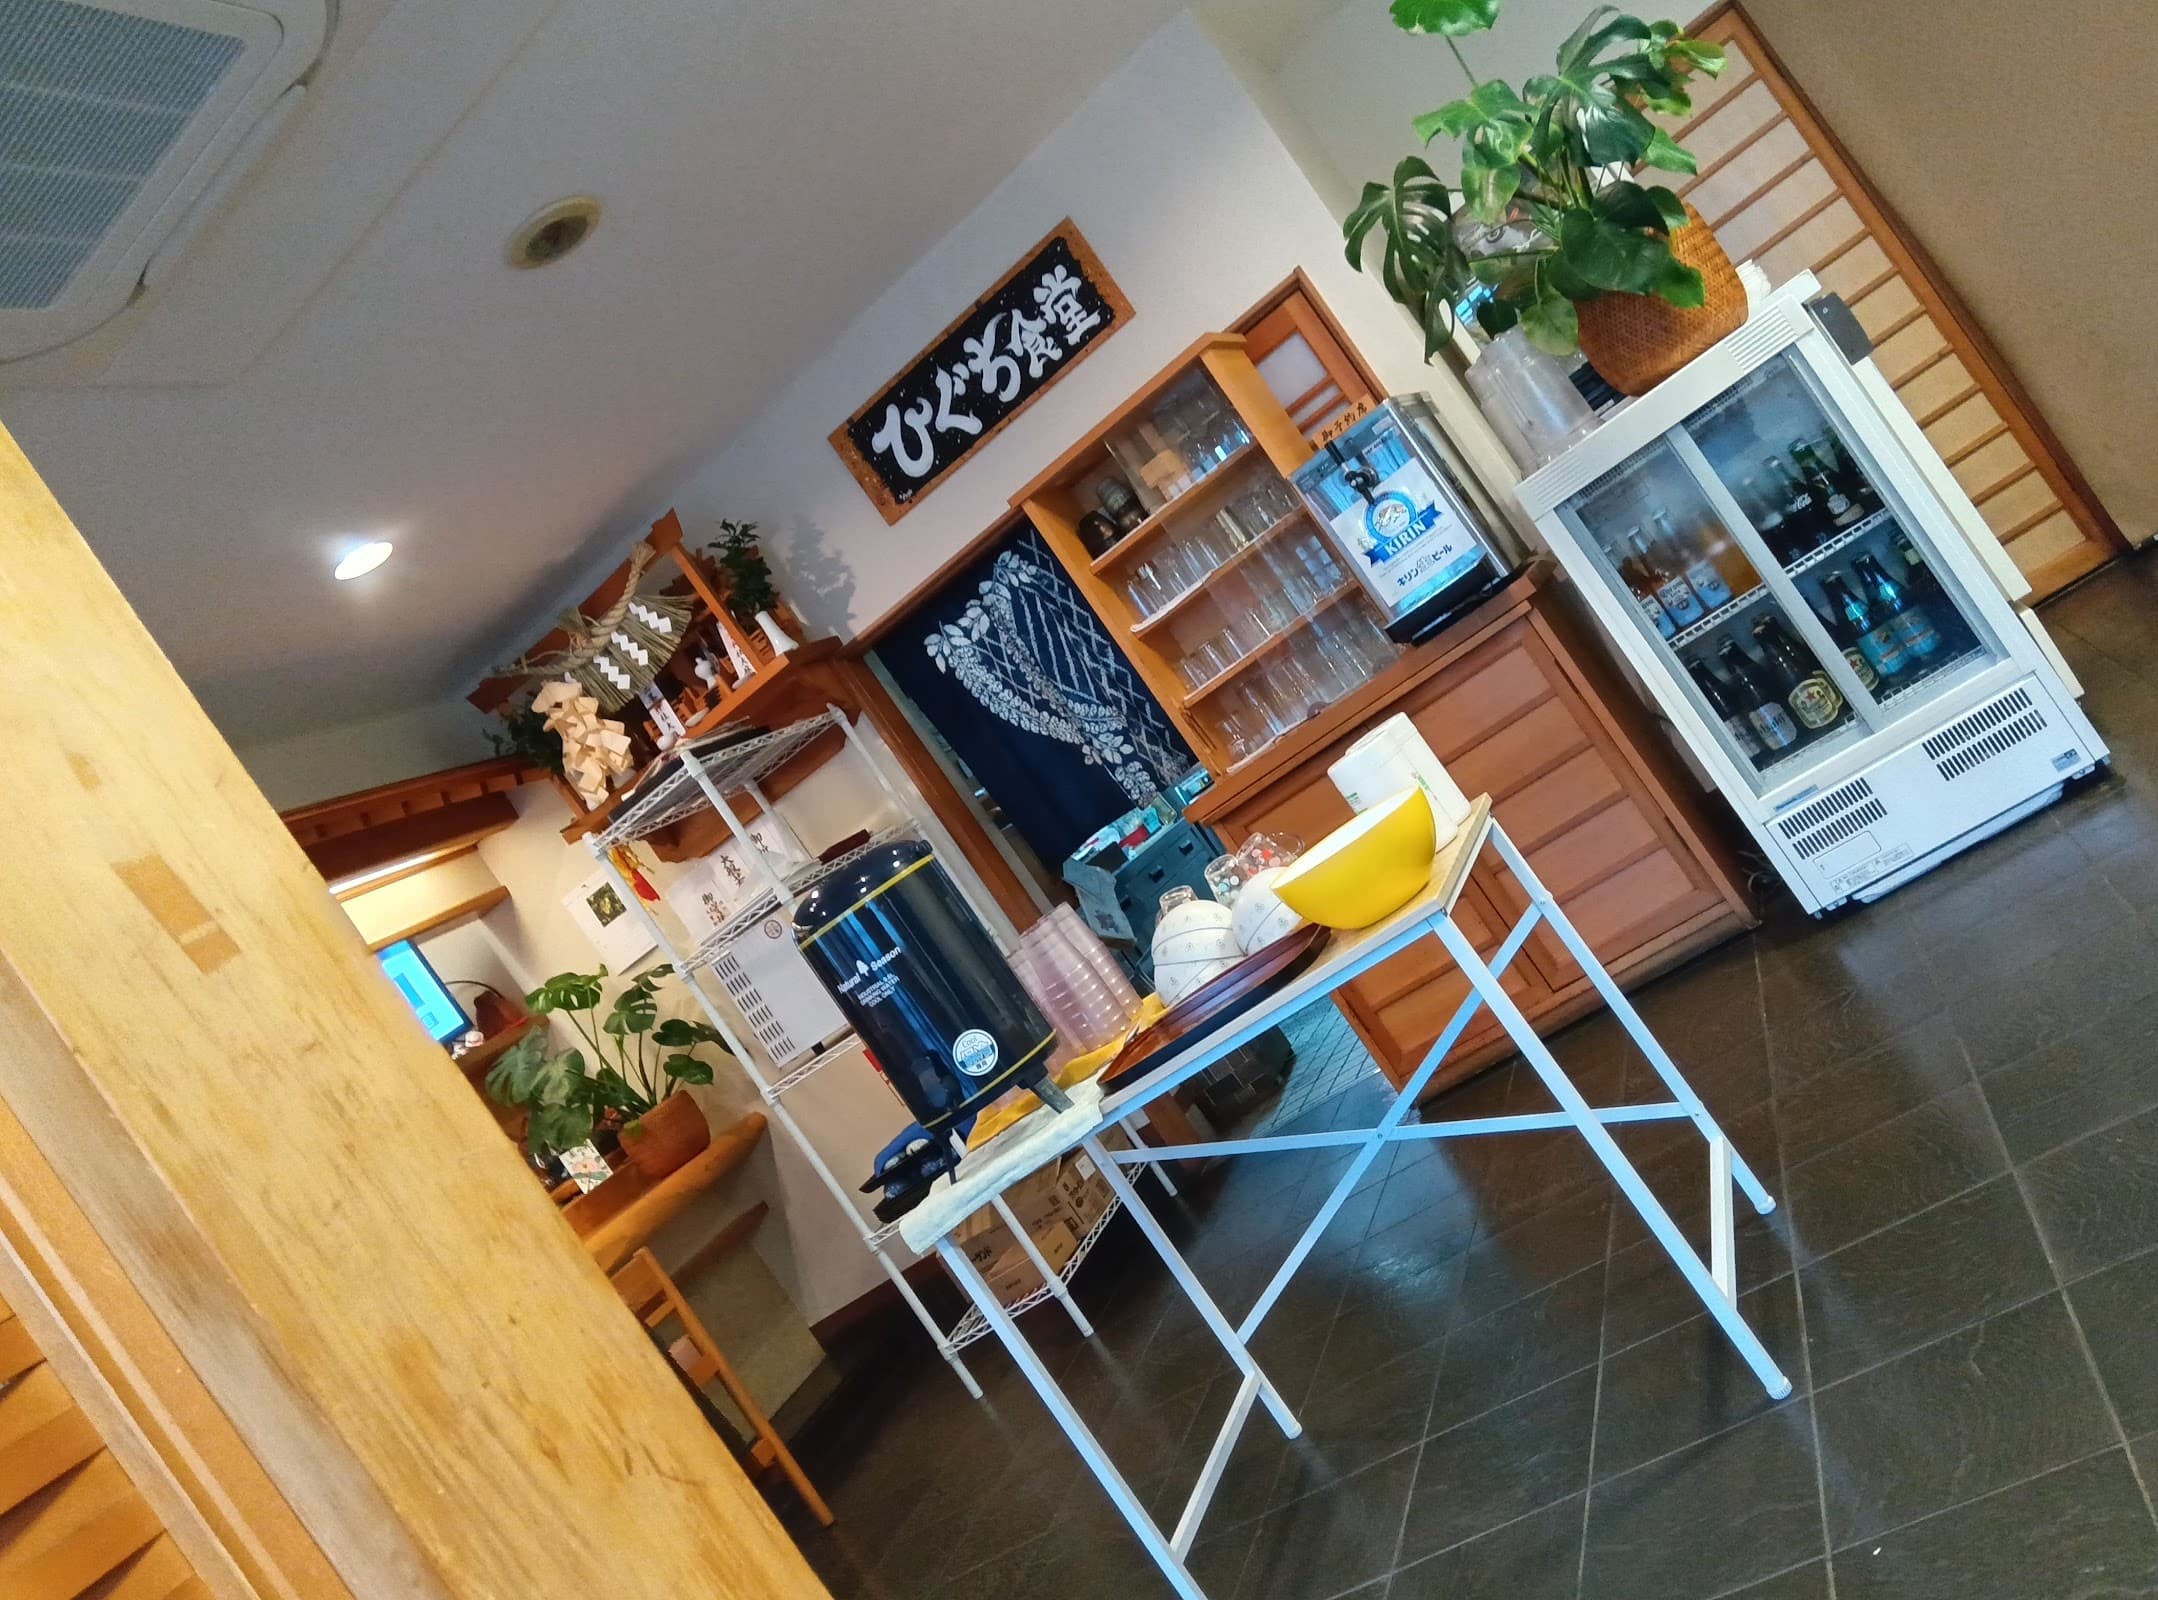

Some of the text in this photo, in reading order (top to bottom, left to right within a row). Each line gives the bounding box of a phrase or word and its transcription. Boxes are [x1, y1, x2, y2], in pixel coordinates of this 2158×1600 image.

[872, 264, 1101, 478] ひぐち食堂
[1385, 520, 1427, 557] KIRIN
[870, 945, 902, 972] Season
